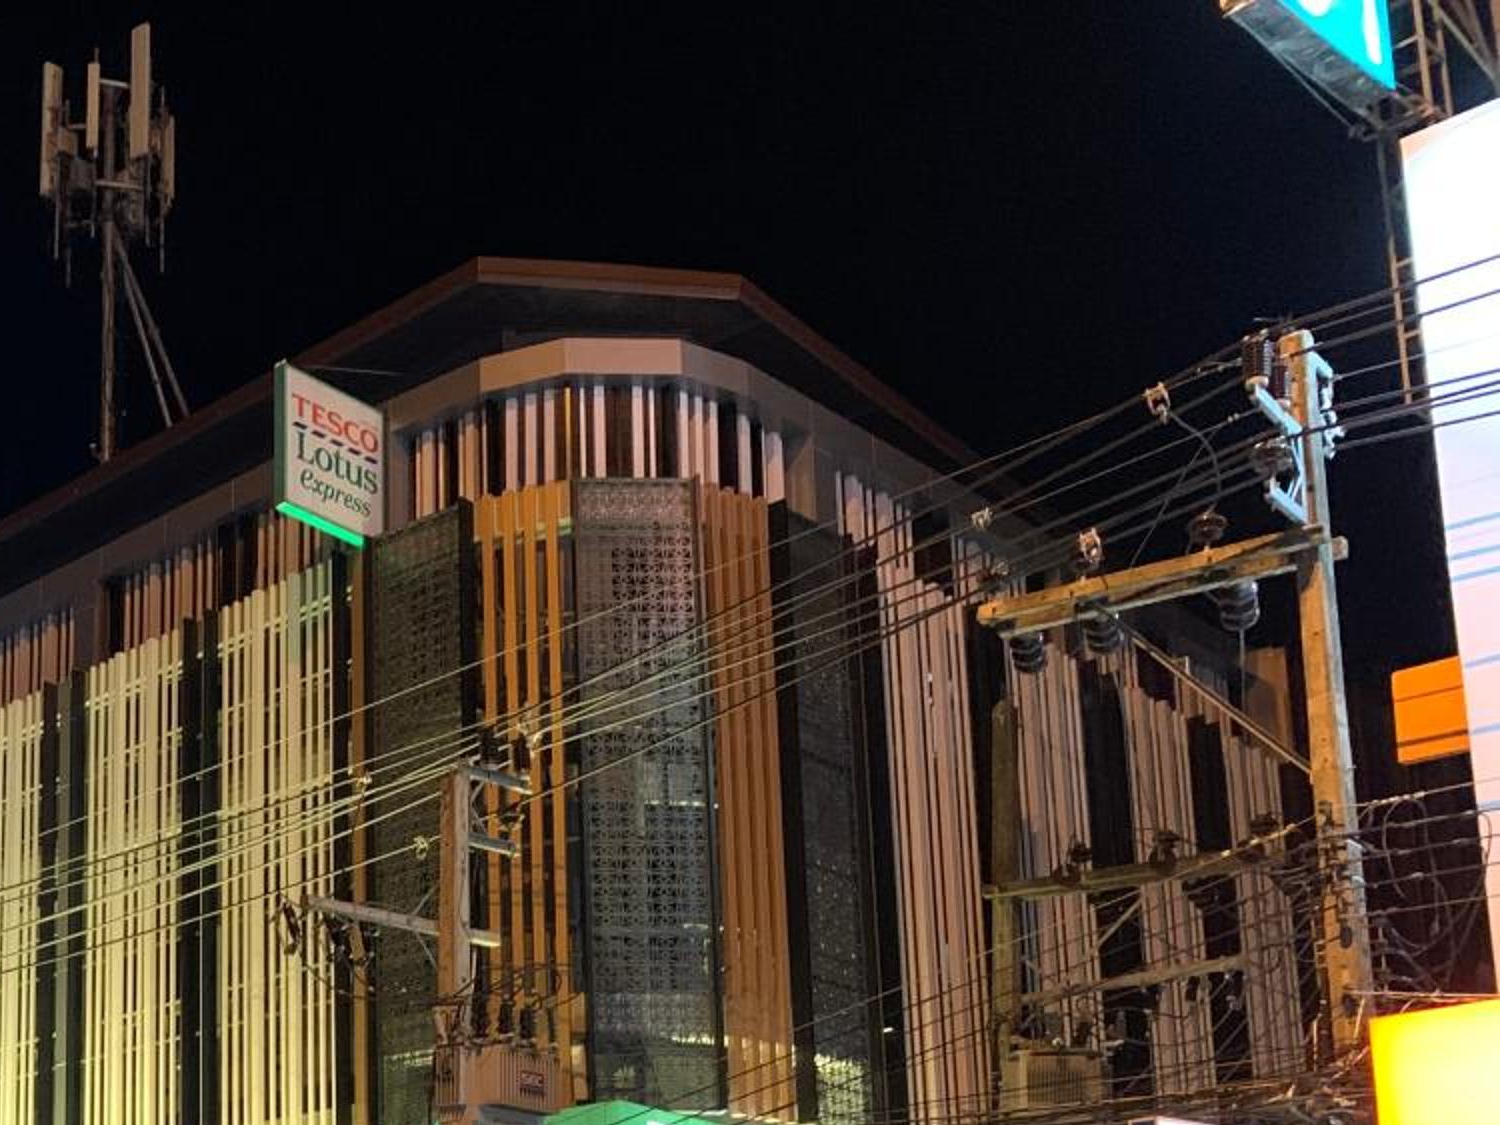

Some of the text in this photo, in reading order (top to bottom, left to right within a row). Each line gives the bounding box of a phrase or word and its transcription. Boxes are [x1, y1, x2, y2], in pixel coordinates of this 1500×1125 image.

[291, 393, 379, 454] TESCO
[296, 431, 379, 494] Lotus
[300, 468, 372, 518] express
